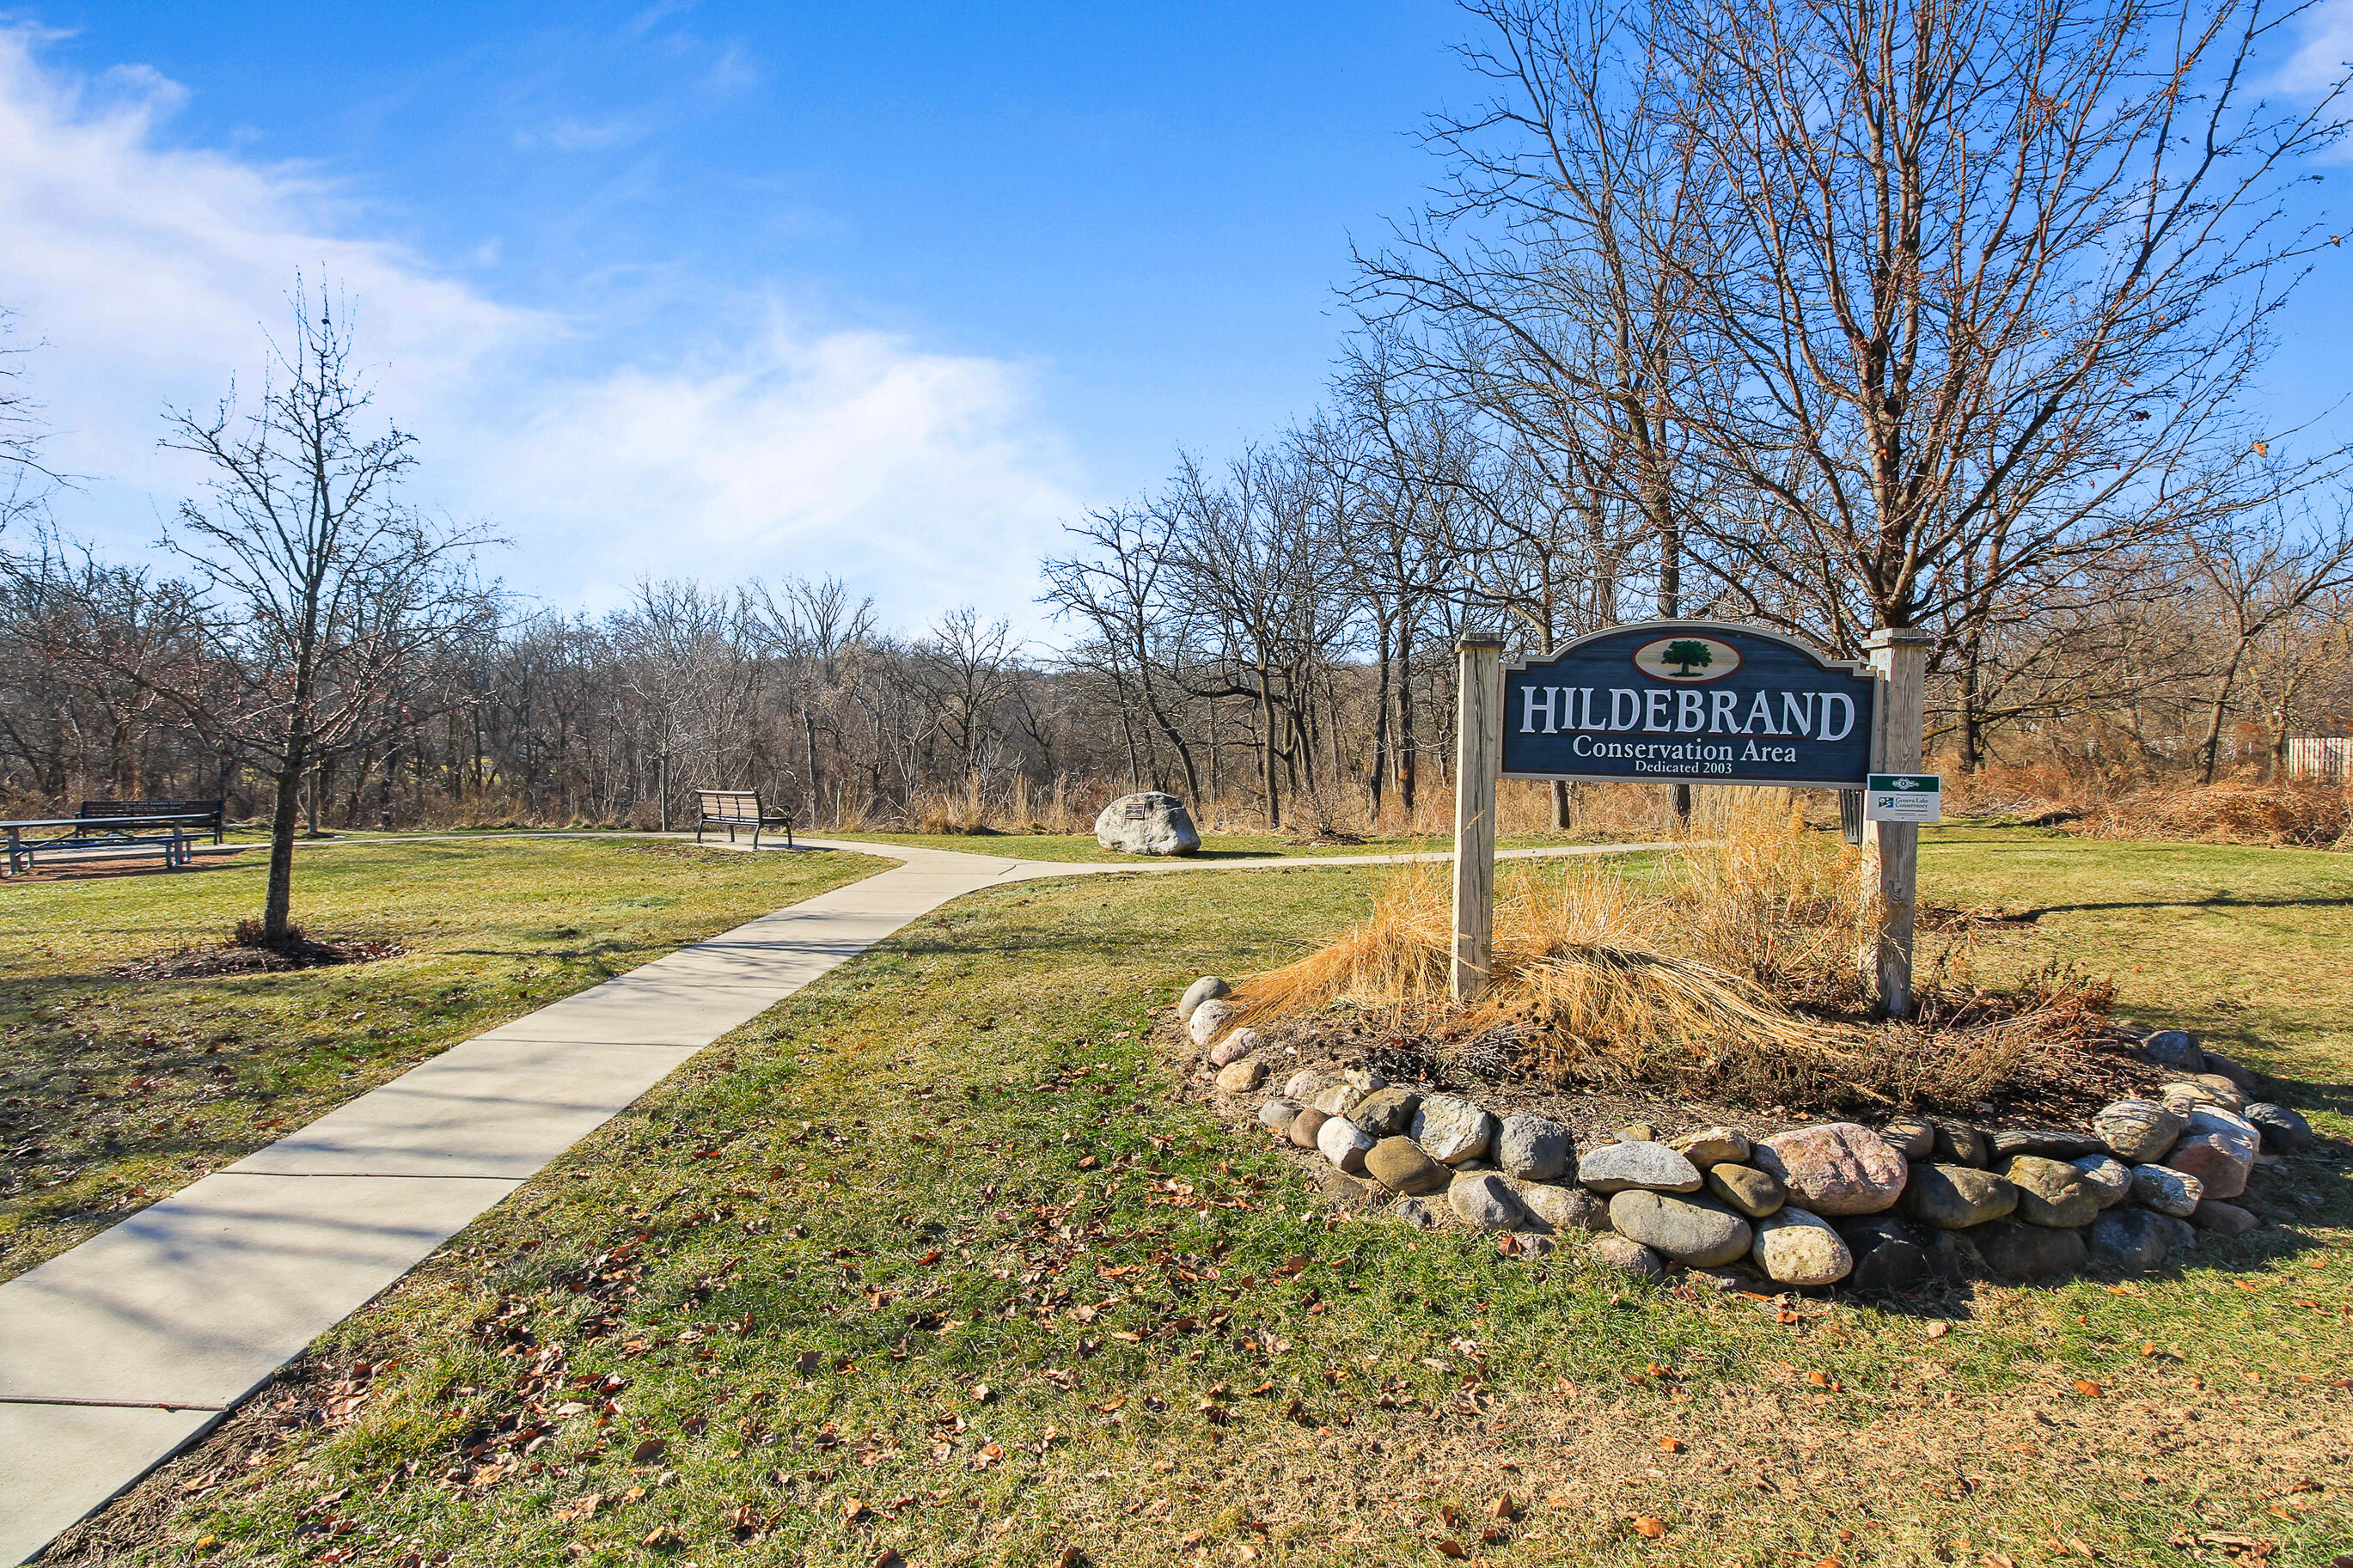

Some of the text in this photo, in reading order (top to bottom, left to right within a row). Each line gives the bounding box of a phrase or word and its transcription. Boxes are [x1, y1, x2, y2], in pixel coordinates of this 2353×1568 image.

[1519, 686, 1855, 741] HILDEBRAND
[1573, 735, 1797, 763] Conservation Area
[1635, 760, 1733, 774] Dedicated 2003
